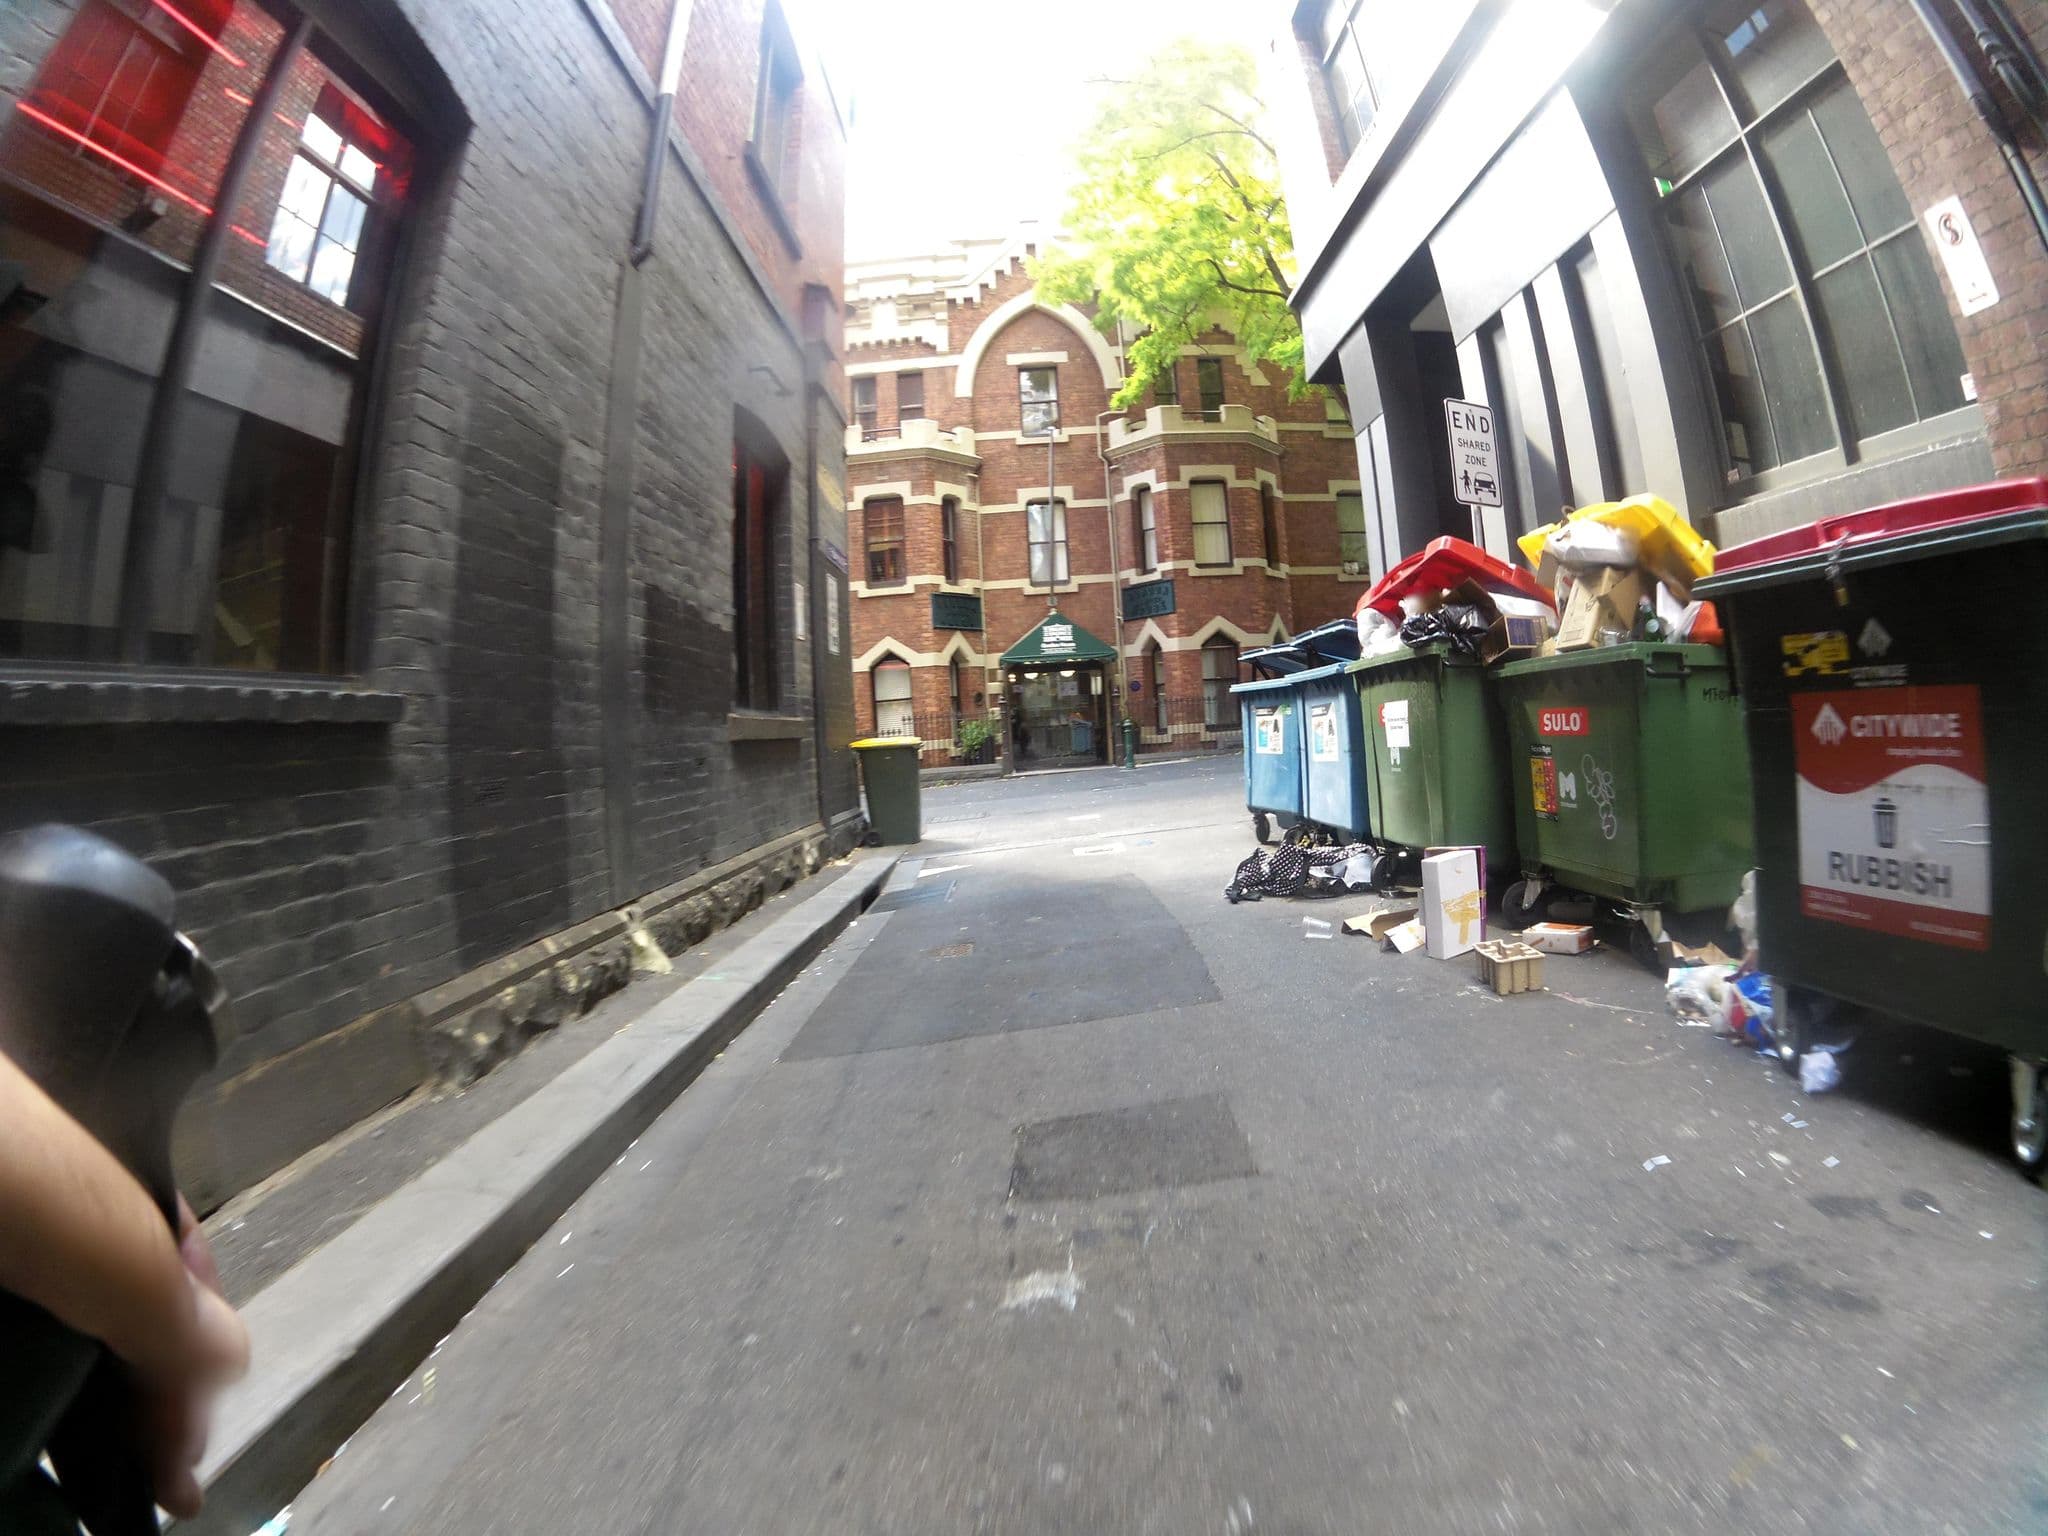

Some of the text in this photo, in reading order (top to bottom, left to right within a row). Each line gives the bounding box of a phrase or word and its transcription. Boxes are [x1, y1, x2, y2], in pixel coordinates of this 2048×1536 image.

[1452, 411, 1490, 432] END
[1457, 437, 1491, 452] SHARED
[1465, 454, 1487, 467] ZONE
[1543, 712, 1581, 732] SULO
[1850, 713, 1962, 738] CITYWIDE
[1827, 851, 1953, 899] RUBBISH
